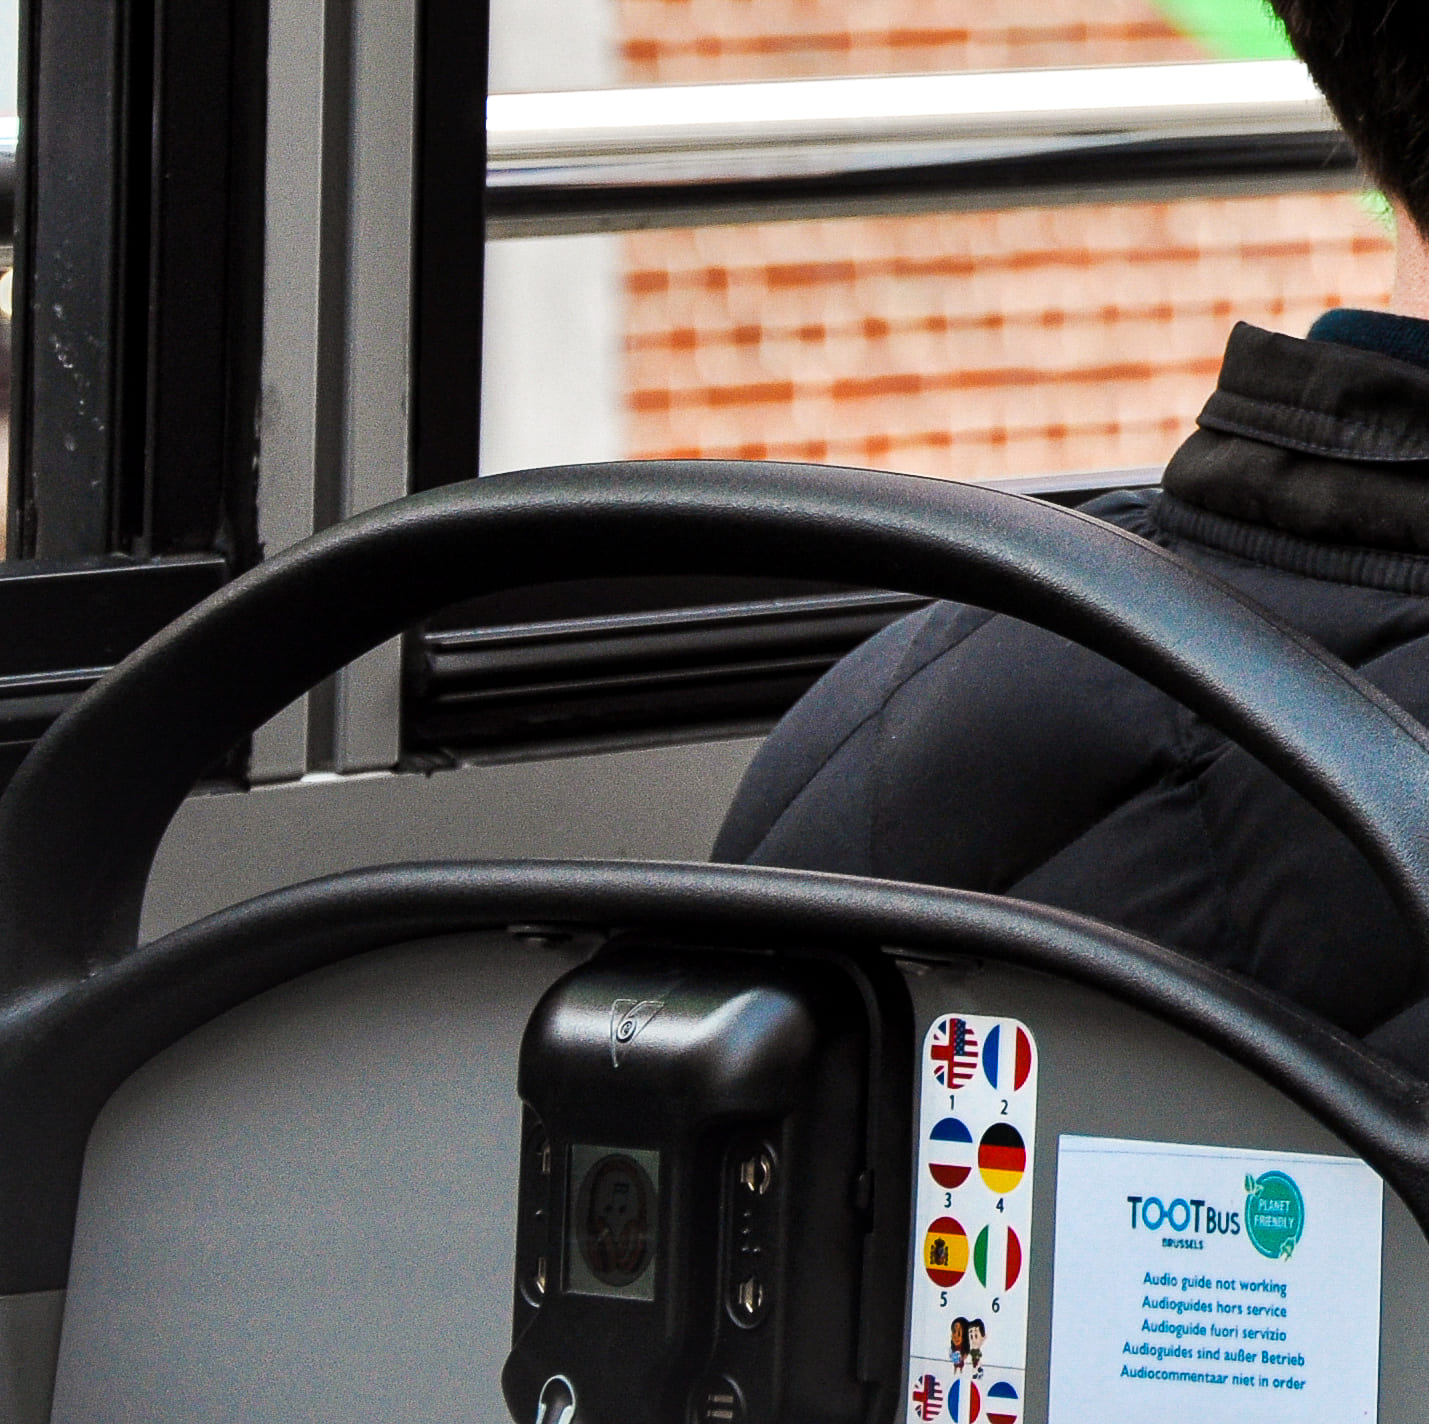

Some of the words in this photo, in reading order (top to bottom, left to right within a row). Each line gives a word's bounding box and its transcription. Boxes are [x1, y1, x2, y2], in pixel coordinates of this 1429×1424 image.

[949, 1095, 955, 1111] 1
[1000, 1100, 1008, 1116] 2
[944, 1193, 952, 1209] 3
[996, 1198, 1004, 1213] 4
[1257, 1198, 1292, 1212] PLANET
[1253, 1214, 1295, 1229] FRIENDLY
[1162, 1238, 1204, 1250] BRUSSELS
[1143, 1272, 1177, 1286] Audio
[1181, 1275, 1212, 1291] guide
[1216, 1279, 1236, 1290] not
[1239, 1280, 1287, 1298] working
[940, 1291, 947, 1307] 5
[991, 1298, 1000, 1313] 6
[1142, 1296, 1213, 1315] Audioguides
[1216, 1300, 1243, 1315] hors
[1247, 1304, 1287, 1318] service
[1141, 1319, 1206, 1338] Audioguide
[1210, 1323, 1239, 1338] fuori
[1242, 1326, 1287, 1341] servizio
[1122, 1342, 1193, 1361] Audioguides
[1197, 1347, 1220, 1361] sind
[1224, 1349, 1258, 1363] außer
[1261, 1351, 1305, 1367] Betrieb
[1120, 1365, 1229, 1384] Audiocommentaar
[1232, 1372, 1255, 1387] niet
[1258, 1374, 1269, 1387] in
[1272, 1376, 1306, 1390] order
